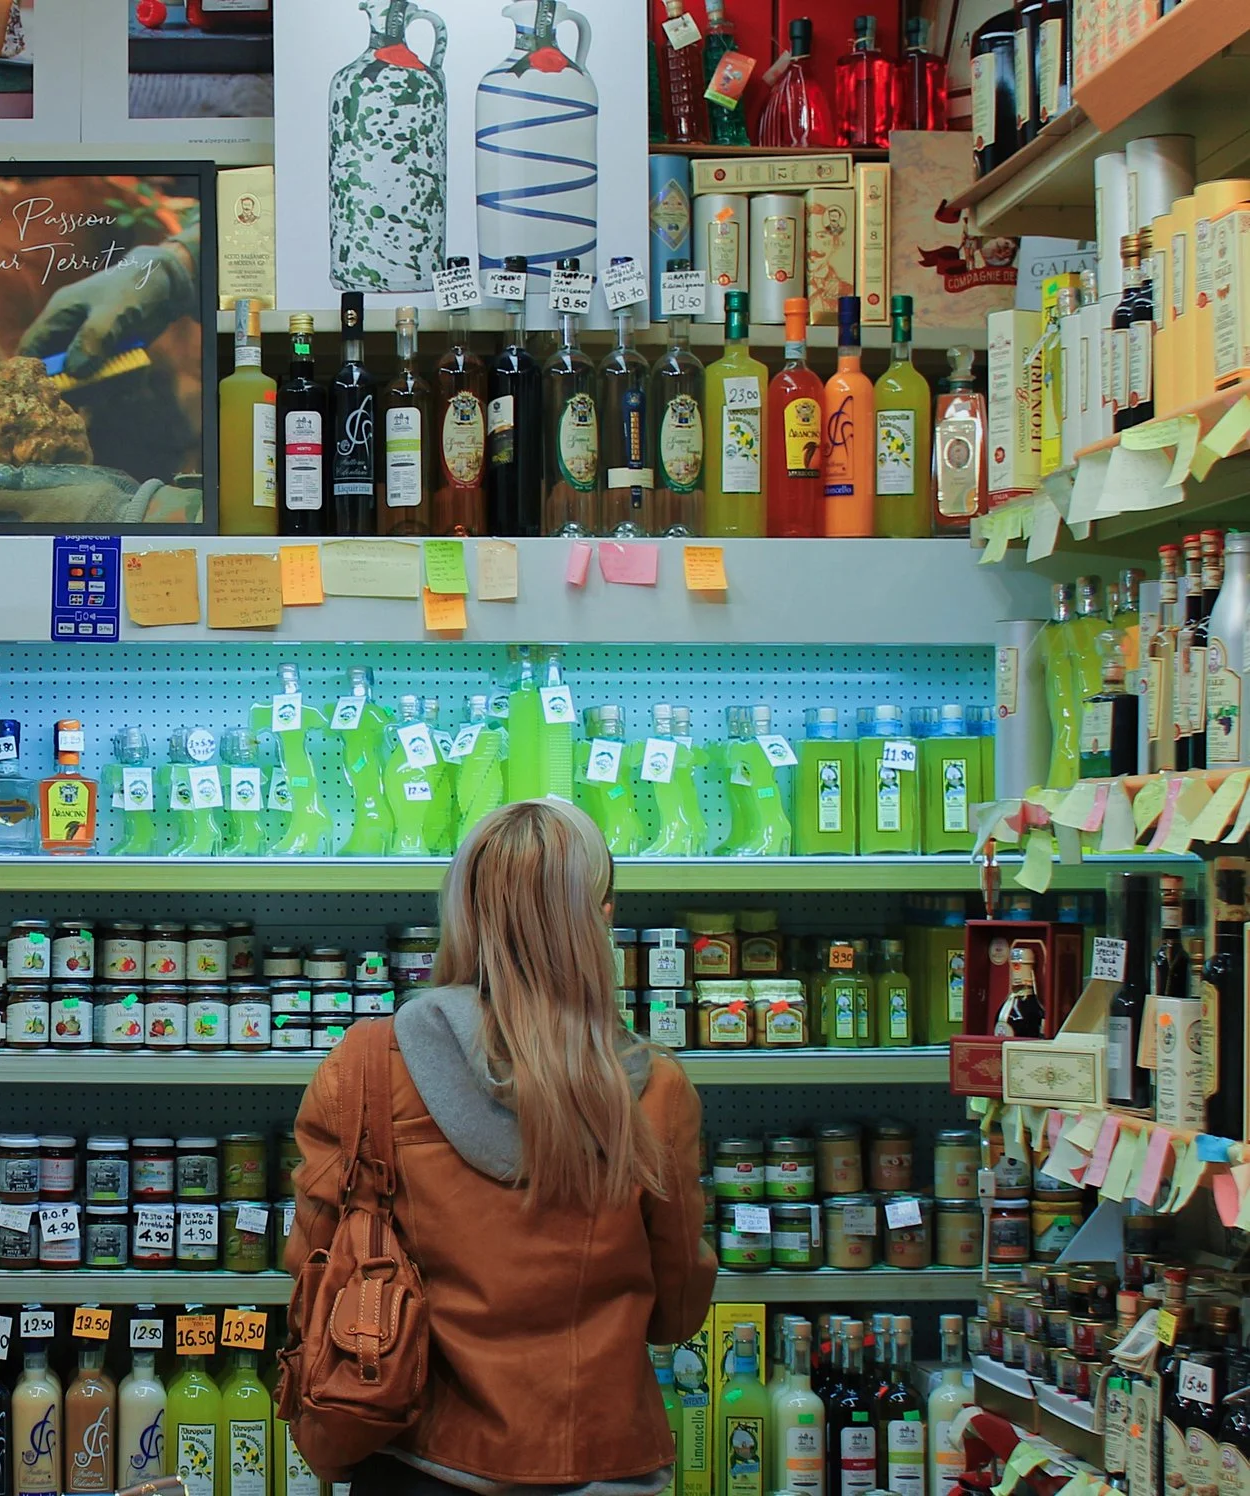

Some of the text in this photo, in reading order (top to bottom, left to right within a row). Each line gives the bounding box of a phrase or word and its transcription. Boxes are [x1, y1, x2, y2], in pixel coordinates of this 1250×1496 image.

[12, 197, 117, 242] Passion
[21, 240, 161, 290] Territory
[948, 270, 1001, 289] COMPAGNIE
[493, 283, 521, 295] 17.50
[611, 287, 644, 305] 18.70
[442, 290, 478, 307] 19.50
[552, 296, 588, 309] 19.50
[670, 294, 701, 311] 19.50
[788, 428, 820, 438] ARANCINO
[884, 748, 915, 762] 11.90
[52, 808, 87, 819] ARANCINO
[1095, 939, 1125, 950] BALSAMIC
[1095, 949, 1121, 957] SPECIAL
[140, 1212, 163, 1220] PESTO
[184, 1218, 214, 1226] LIMONE
[47, 1222, 76, 1236] 4.90
[138, 1229, 169, 1243] 4.90
[184, 1228, 213, 1241] 4.90
[23, 1318, 53, 1334] 12.50
[75, 1315, 109, 1331] 12.50
[133, 1326, 162, 1341] 12.50
[177, 1330, 215, 1347] 16.50
[691, 1409, 705, 1470] Limoncello
